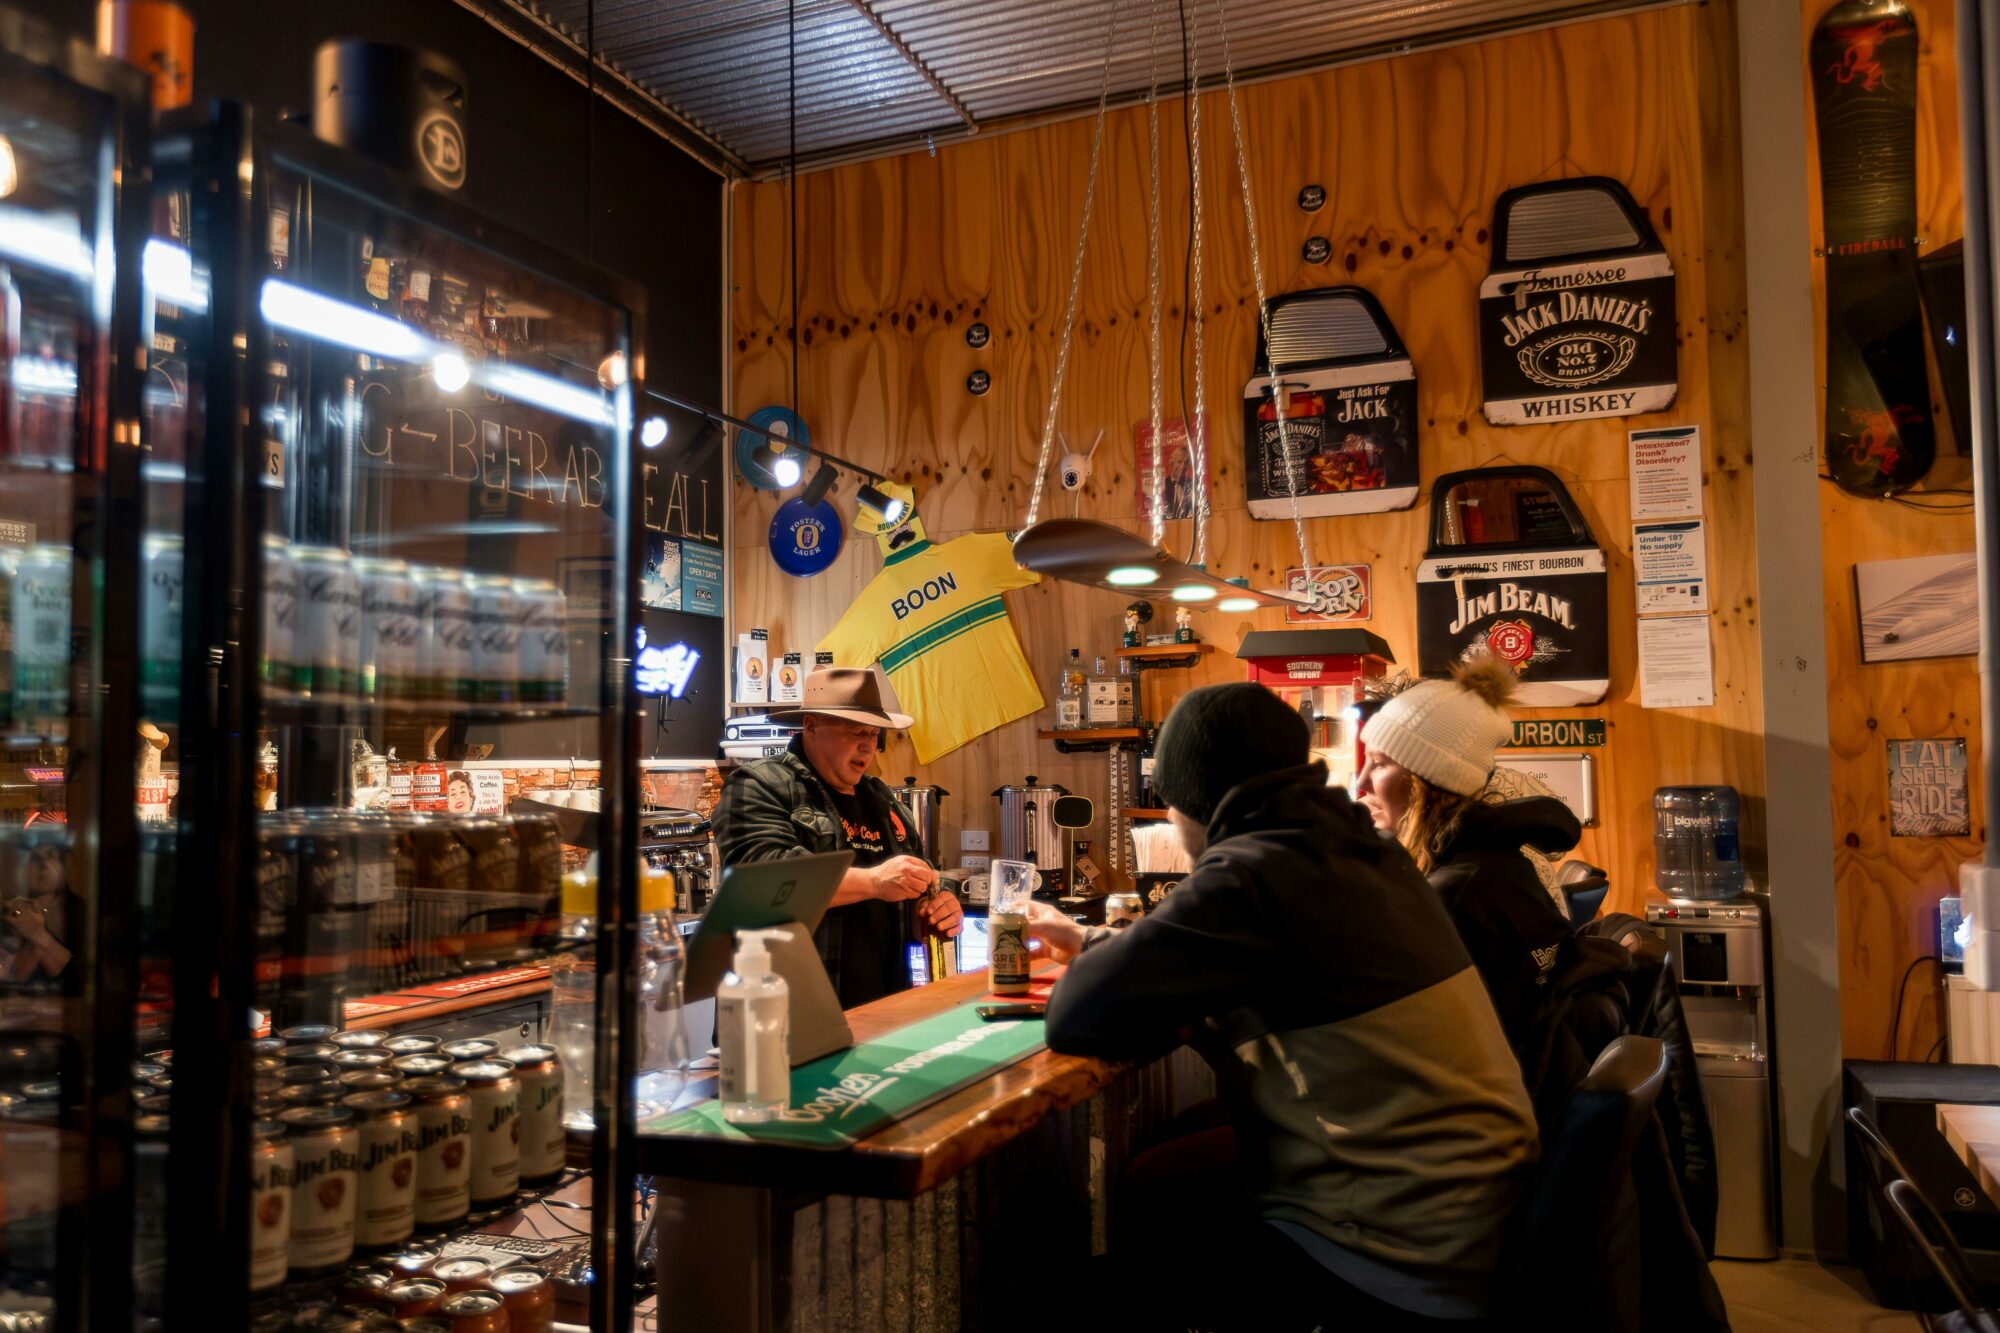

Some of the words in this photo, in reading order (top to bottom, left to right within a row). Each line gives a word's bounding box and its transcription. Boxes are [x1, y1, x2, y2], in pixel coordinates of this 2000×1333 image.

[1523, 267, 1626, 292] Tennessee
[1501, 302, 1559, 347] JACK
[1559, 291, 1652, 333] DANIEL'S
[1560, 342, 1593, 356] Old
[1558, 366, 1596, 376] BRAND
[1357, 386, 1373, 397] Ask
[1338, 398, 1388, 423] JACK
[1521, 392, 1637, 418] WHISKEY
[1635, 440, 1690, 450] Intoxicated?
[1635, 449, 1667, 458] Drunk?
[1636, 456, 1686, 466] Disorderly?
[444, 408, 556, 505] BEER
[664, 471, 720, 543] ALL
[790, 517, 826, 533] FOSTER'S
[793, 546, 822, 557] LAGER
[1502, 559, 1535, 572] FINEST
[1539, 556, 1585, 569] BOURBON
[891, 571, 958, 621] BOON
[1450, 591, 1497, 635] JIM
[1498, 582, 1574, 629] BEAM
[1286, 661, 1324, 671] SOUTHERN
[1289, 670, 1321, 679] COMFORT
[1511, 721, 1585, 746] URBON
[1588, 733, 1603, 744] ST
[1899, 742, 1953, 768] EAT
[1901, 786, 1962, 815] RIDE
